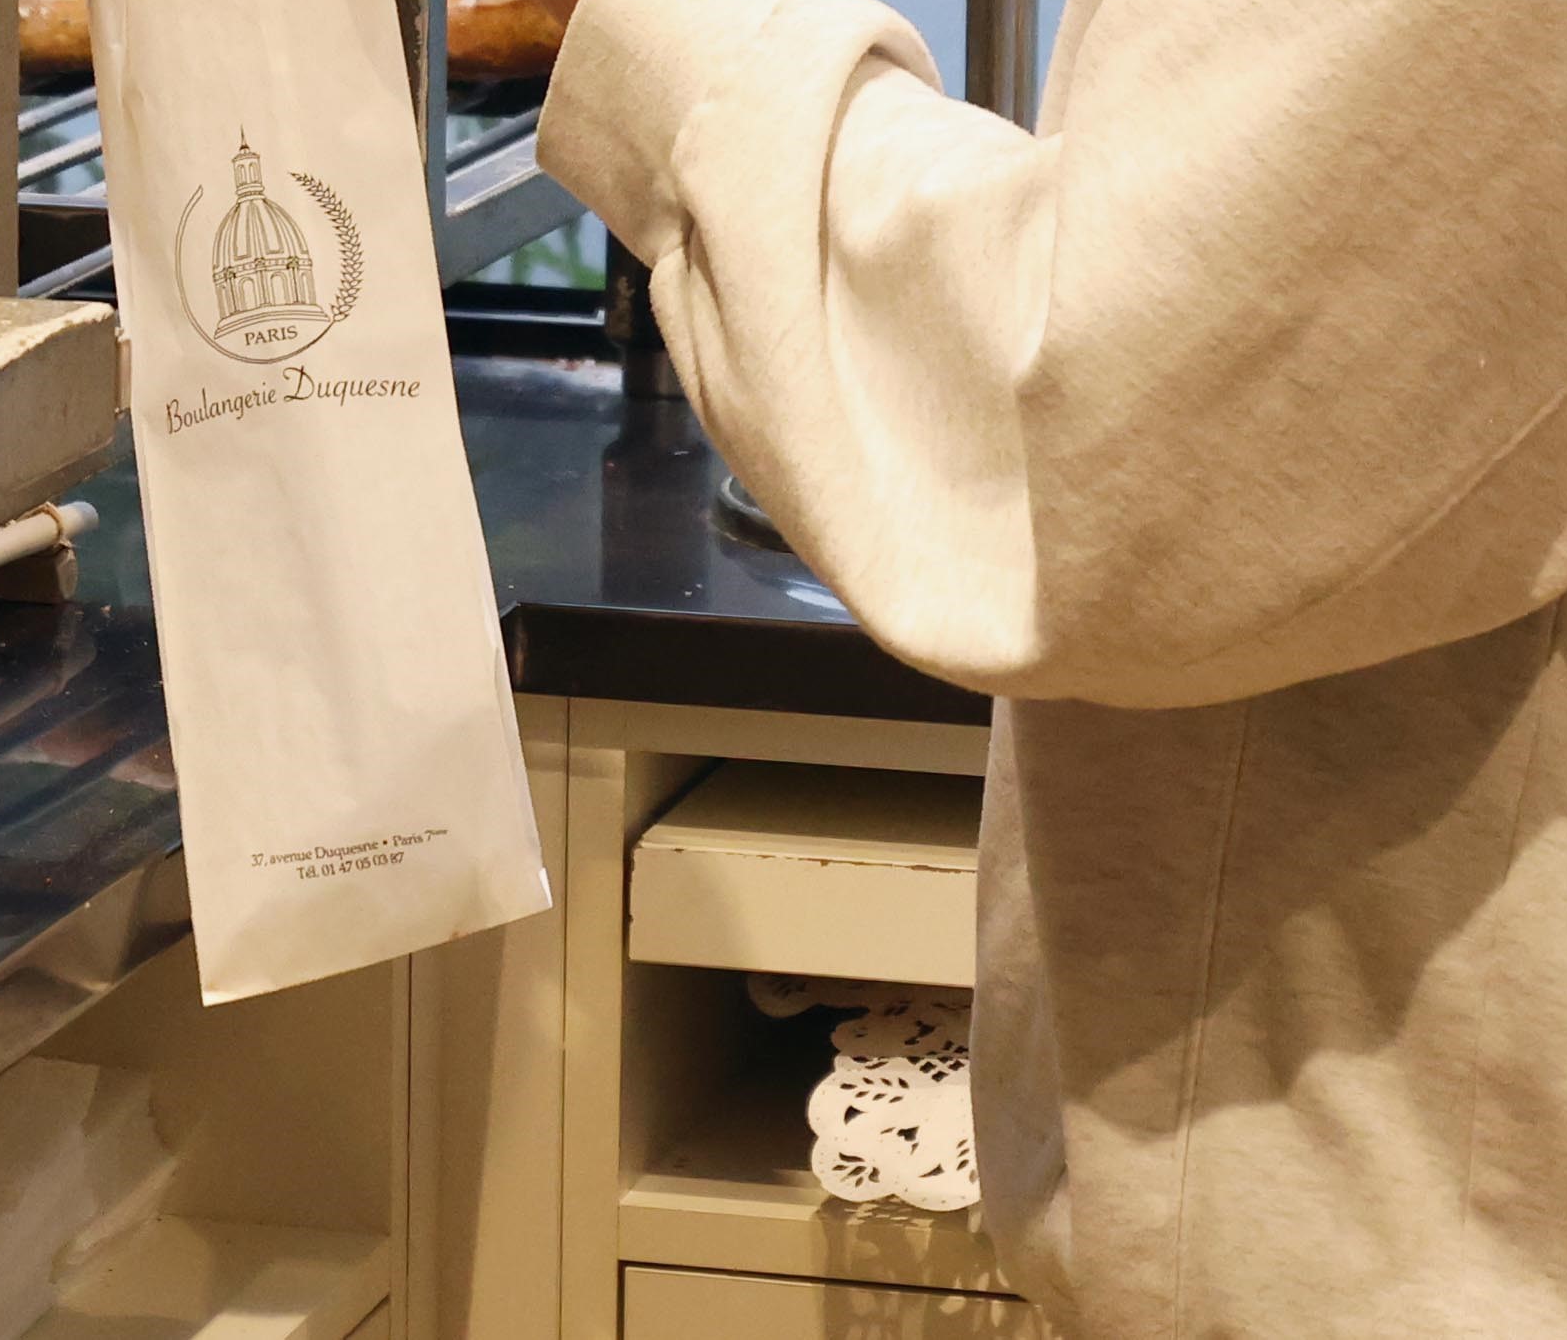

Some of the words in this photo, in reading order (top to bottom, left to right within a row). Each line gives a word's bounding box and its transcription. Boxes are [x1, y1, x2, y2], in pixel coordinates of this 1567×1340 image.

[244, 326, 299, 347] PARIS
[166, 382, 278, 435] Boulangerie
[282, 364, 422, 407] Duquesne
[250, 852, 269, 869] 37,
[270, 850, 313, 866] avenue
[315, 839, 380, 861] Duquesne
[393, 832, 424, 847] Paris
[321, 864, 337, 878] 01
[339, 860, 354, 875] 47
[355, 857, 372, 872] 05
[372, 853, 389, 868] 03
[390, 850, 405, 865] 87
